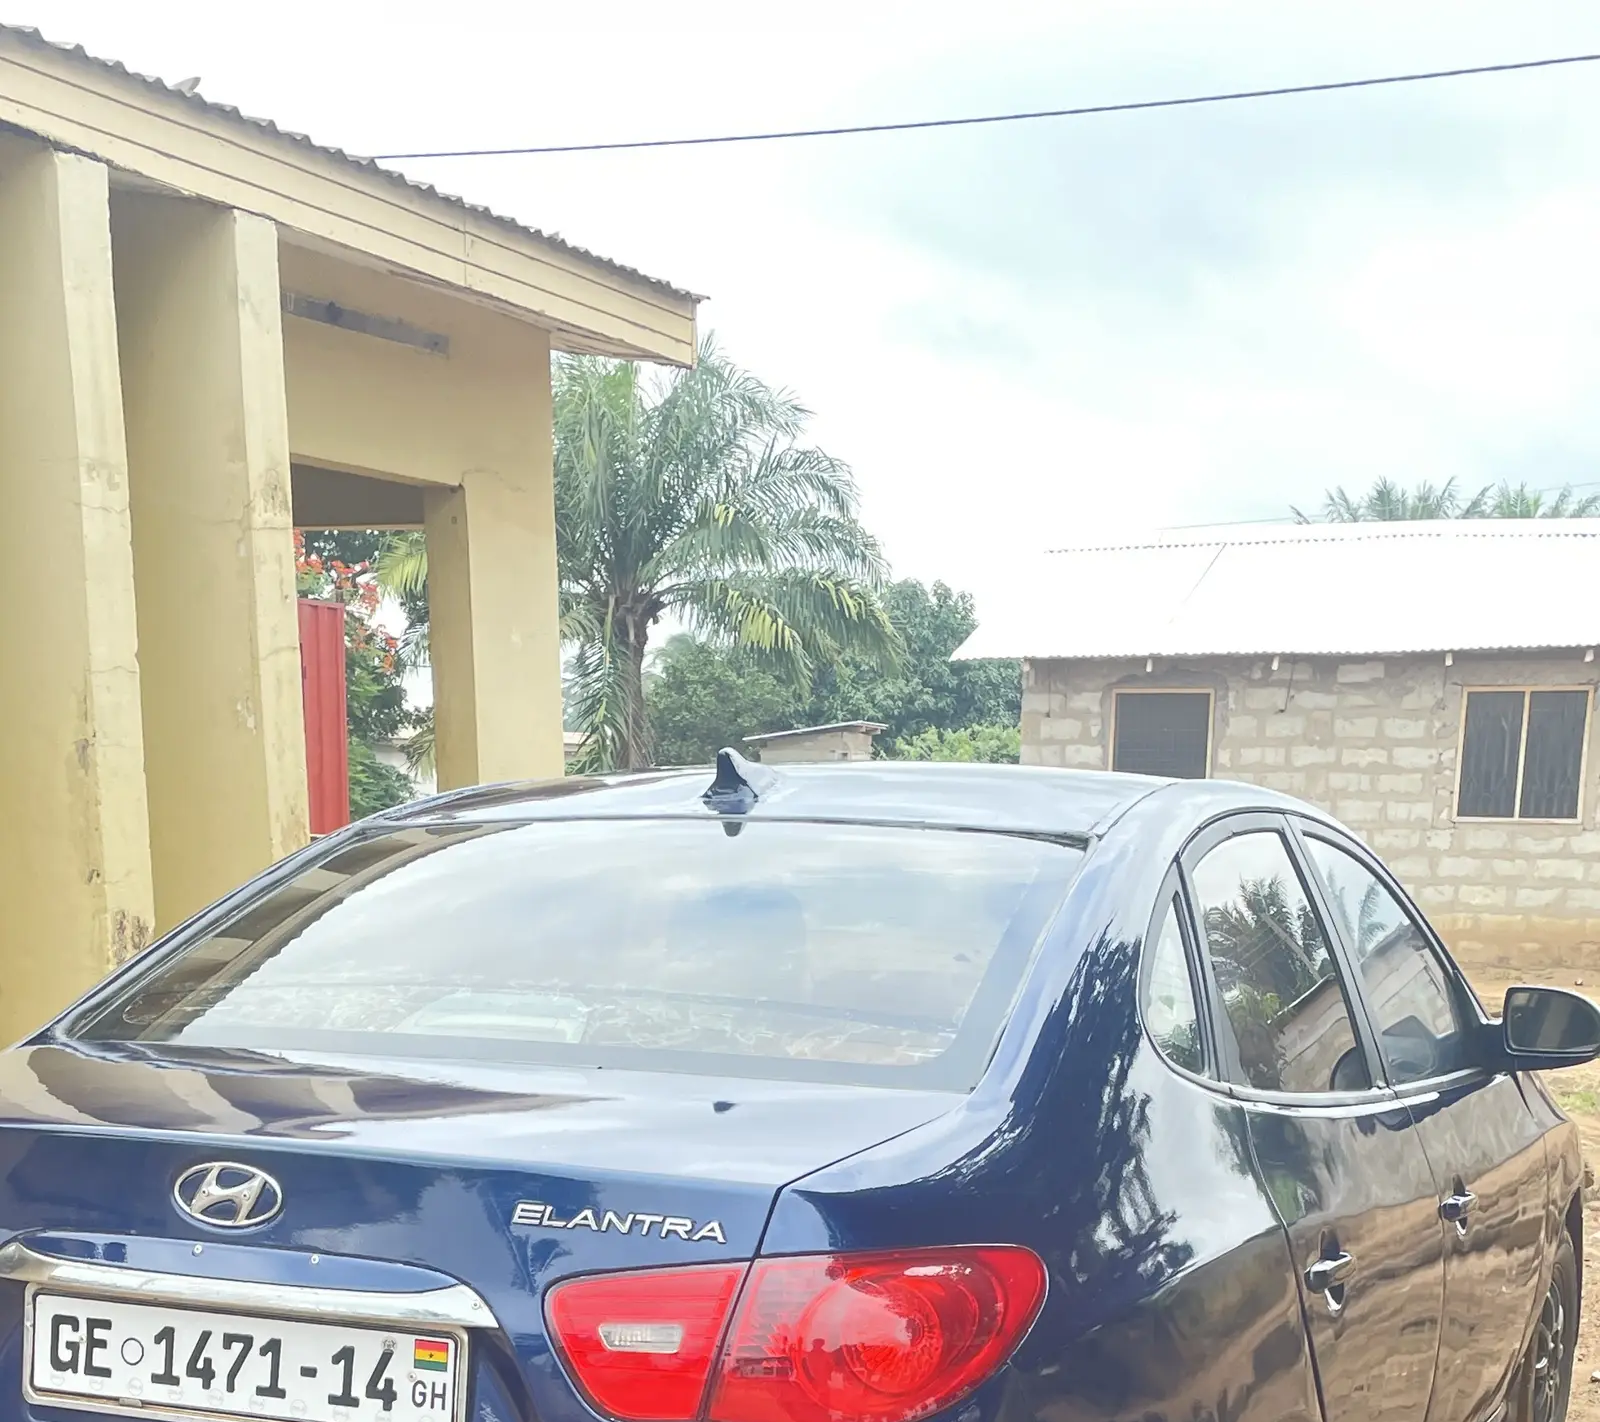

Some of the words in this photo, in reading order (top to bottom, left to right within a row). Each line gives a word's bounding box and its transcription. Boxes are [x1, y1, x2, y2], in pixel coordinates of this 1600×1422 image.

[511, 1202, 727, 1244] ELANTRA
[50, 1314, 112, 1378] GE
[151, 1325, 397, 1411] 1471-14
[411, 1379, 447, 1411] GH
